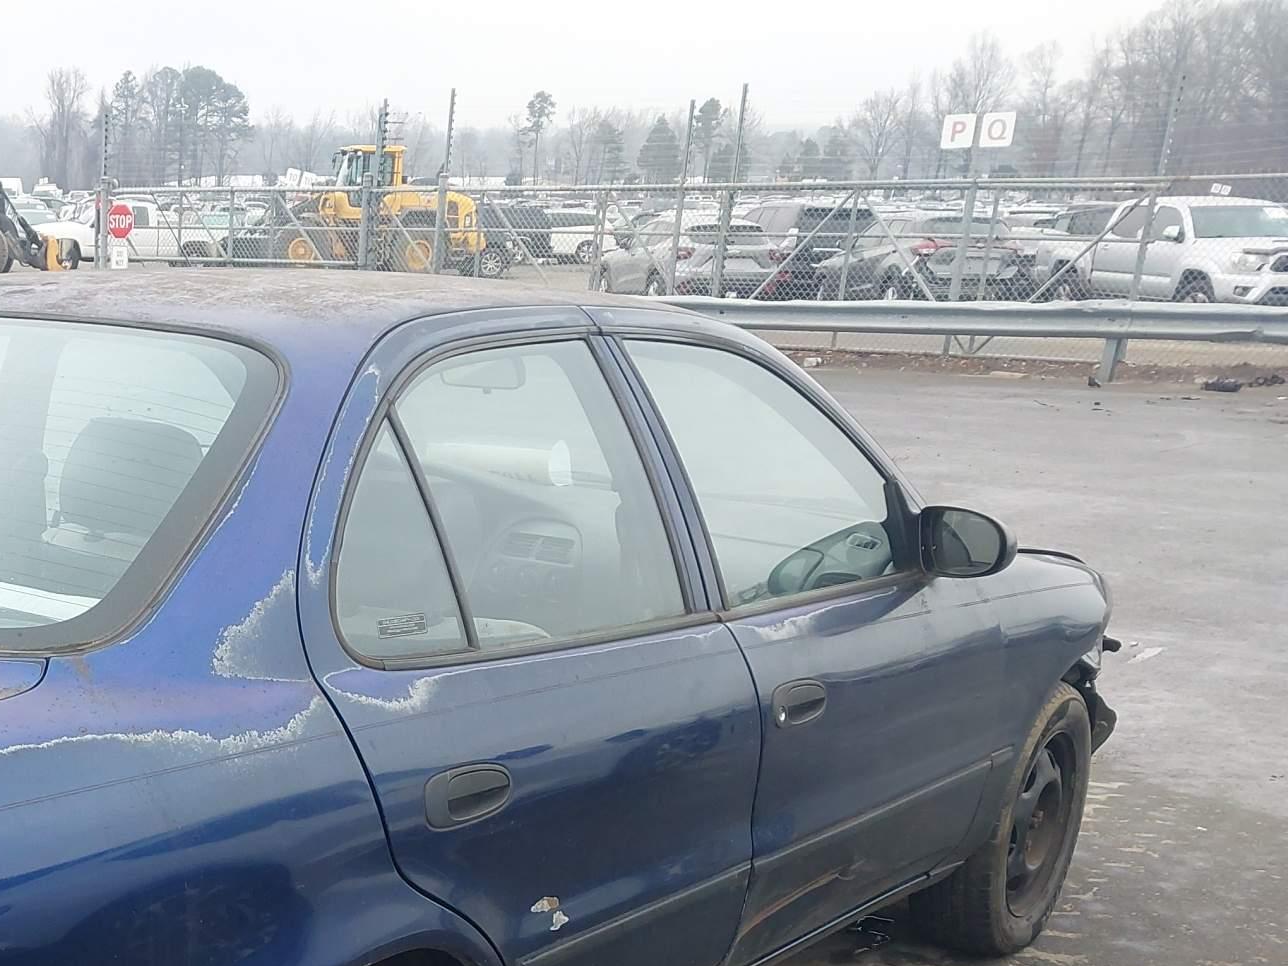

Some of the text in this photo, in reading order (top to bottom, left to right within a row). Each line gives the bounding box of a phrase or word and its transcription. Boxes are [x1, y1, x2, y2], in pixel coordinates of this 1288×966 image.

[950, 121, 967, 143] P
[987, 118, 1007, 141] Q
[109, 214, 133, 229] STOP
